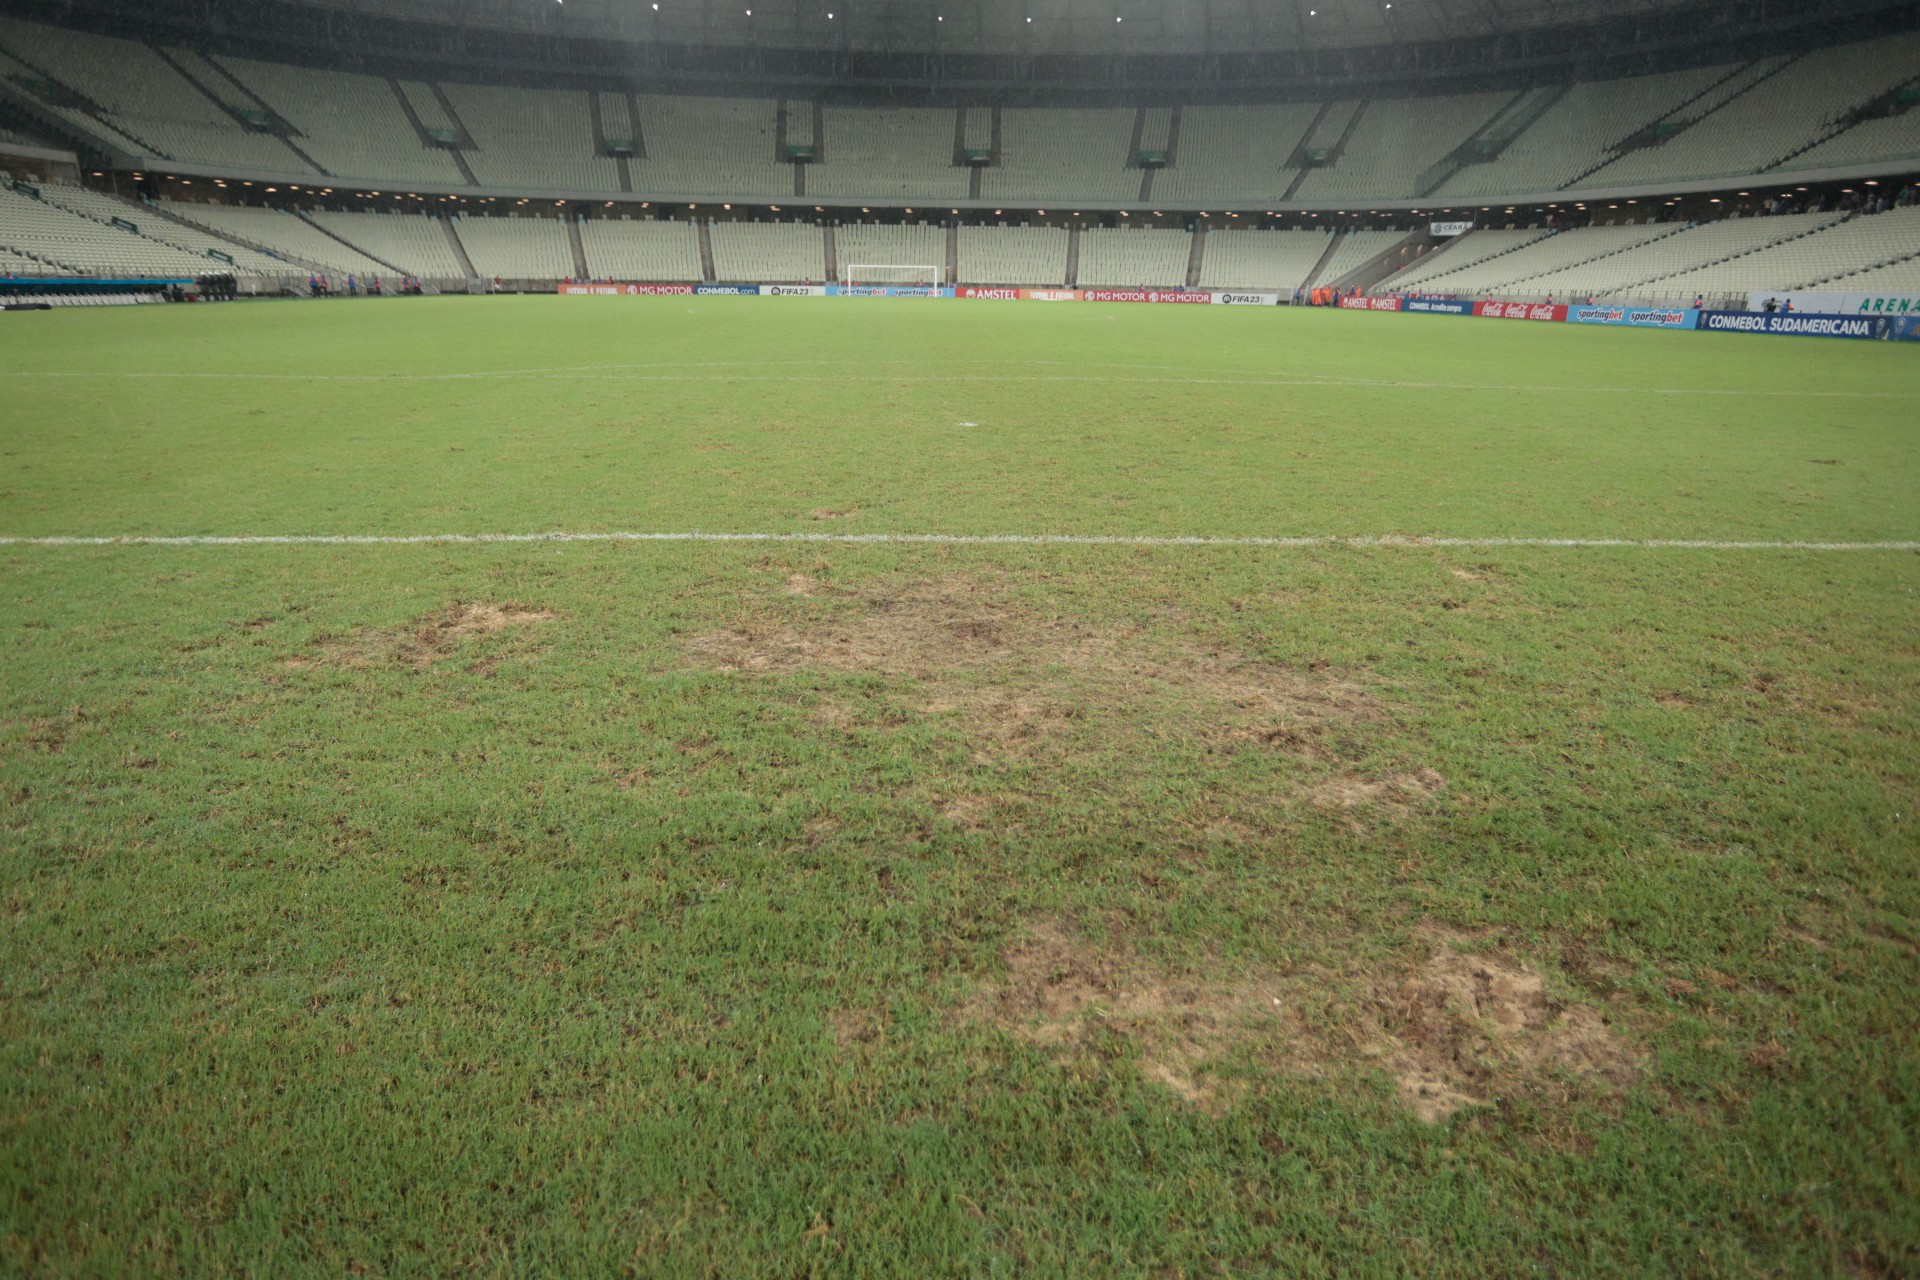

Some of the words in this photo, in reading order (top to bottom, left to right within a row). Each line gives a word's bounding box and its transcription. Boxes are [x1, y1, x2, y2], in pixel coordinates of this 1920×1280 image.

[640, 286, 655, 295] MG
[657, 286, 692, 295] MOTOR
[781, 287, 799, 296] FIFA
[799, 287, 809, 296] 23
[894, 288, 942, 297] sportingbt
[977, 290, 1016, 300] AMSTEL
[1096, 291, 1111, 300] MG
[1112, 291, 1146, 302] MOTOR
[1160, 293, 1175, 302] MG
[1176, 293, 1210, 303] MOTOR
[1232, 295, 1249, 303] FIFA
[1249, 295, 1260, 303] 23
[1348, 297, 1368, 309] AMSTEL
[1376, 298, 1396, 310] AMSTEL
[1858, 297, 1920, 312] ARENA
[1578, 308, 1623, 321] sportingbet
[1630, 310, 1683, 325] sportingbet
[1709, 314, 1767, 331] CONMEBOL
[1769, 317, 1869, 335] SUDAMERICANA
